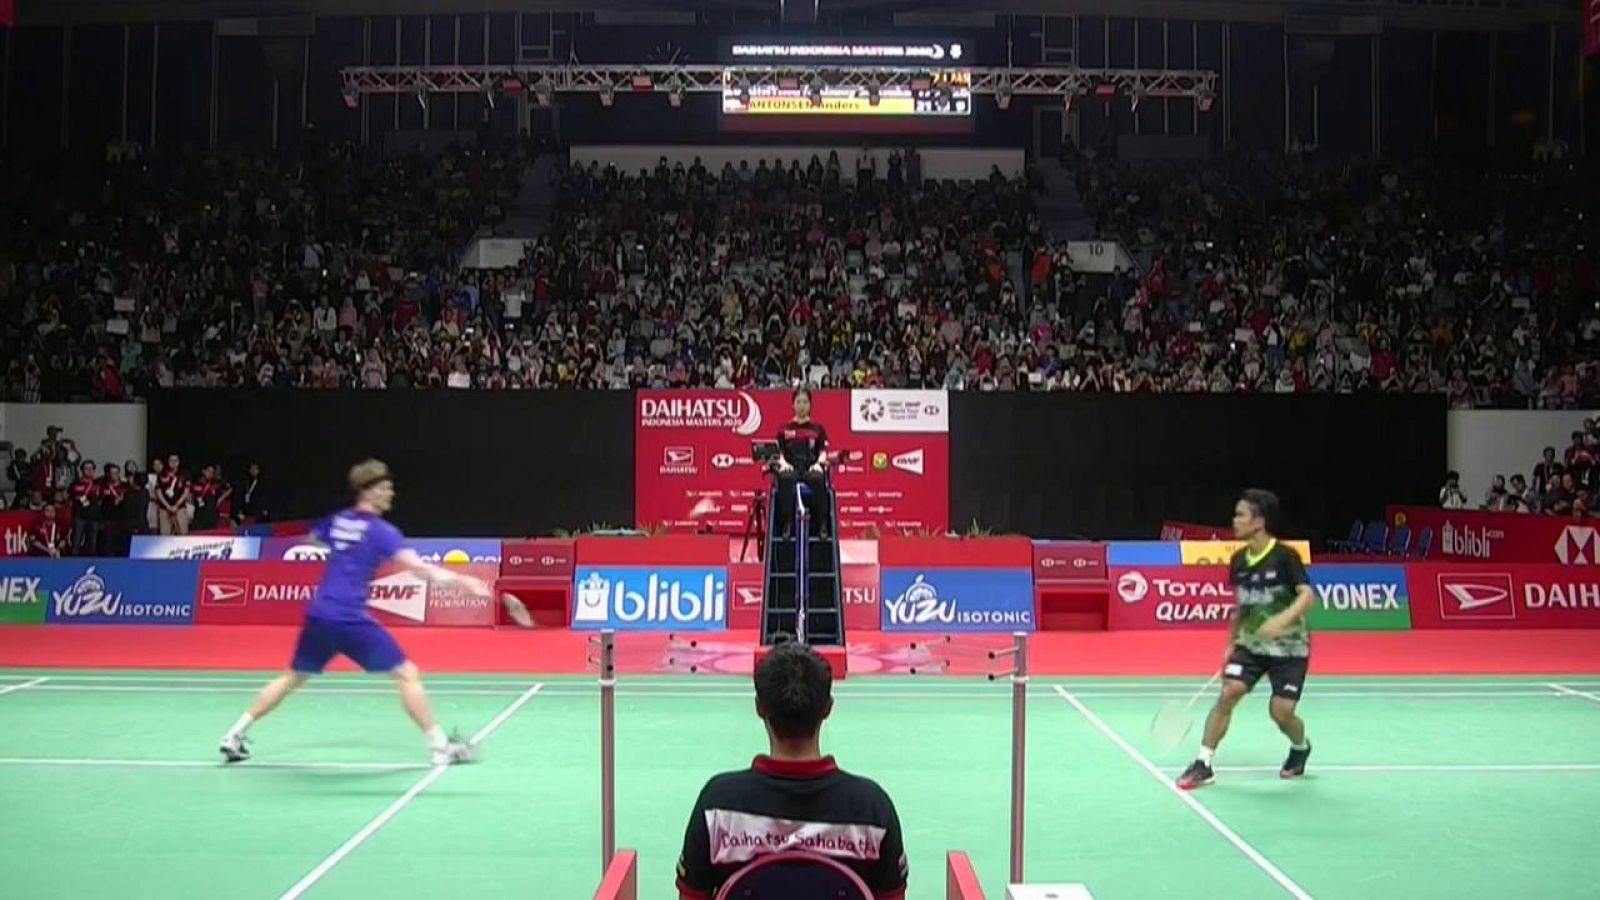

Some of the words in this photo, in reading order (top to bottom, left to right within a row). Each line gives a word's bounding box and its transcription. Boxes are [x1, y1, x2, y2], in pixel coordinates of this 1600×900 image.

[1089, 243, 1105, 256] 10
[641, 398, 741, 418] DAIHATSU
[641, 417, 684, 427] INDONESIA
[685, 417, 721, 427] MASTERS
[53, 586, 122, 617] YUZU
[119, 603, 191, 617] ISOTONIC
[615, 573, 725, 621] blibli
[885, 595, 956, 624] YUZU
[957, 610, 1031, 624] ISOTONIC
[1316, 583, 1400, 610] YONEX
